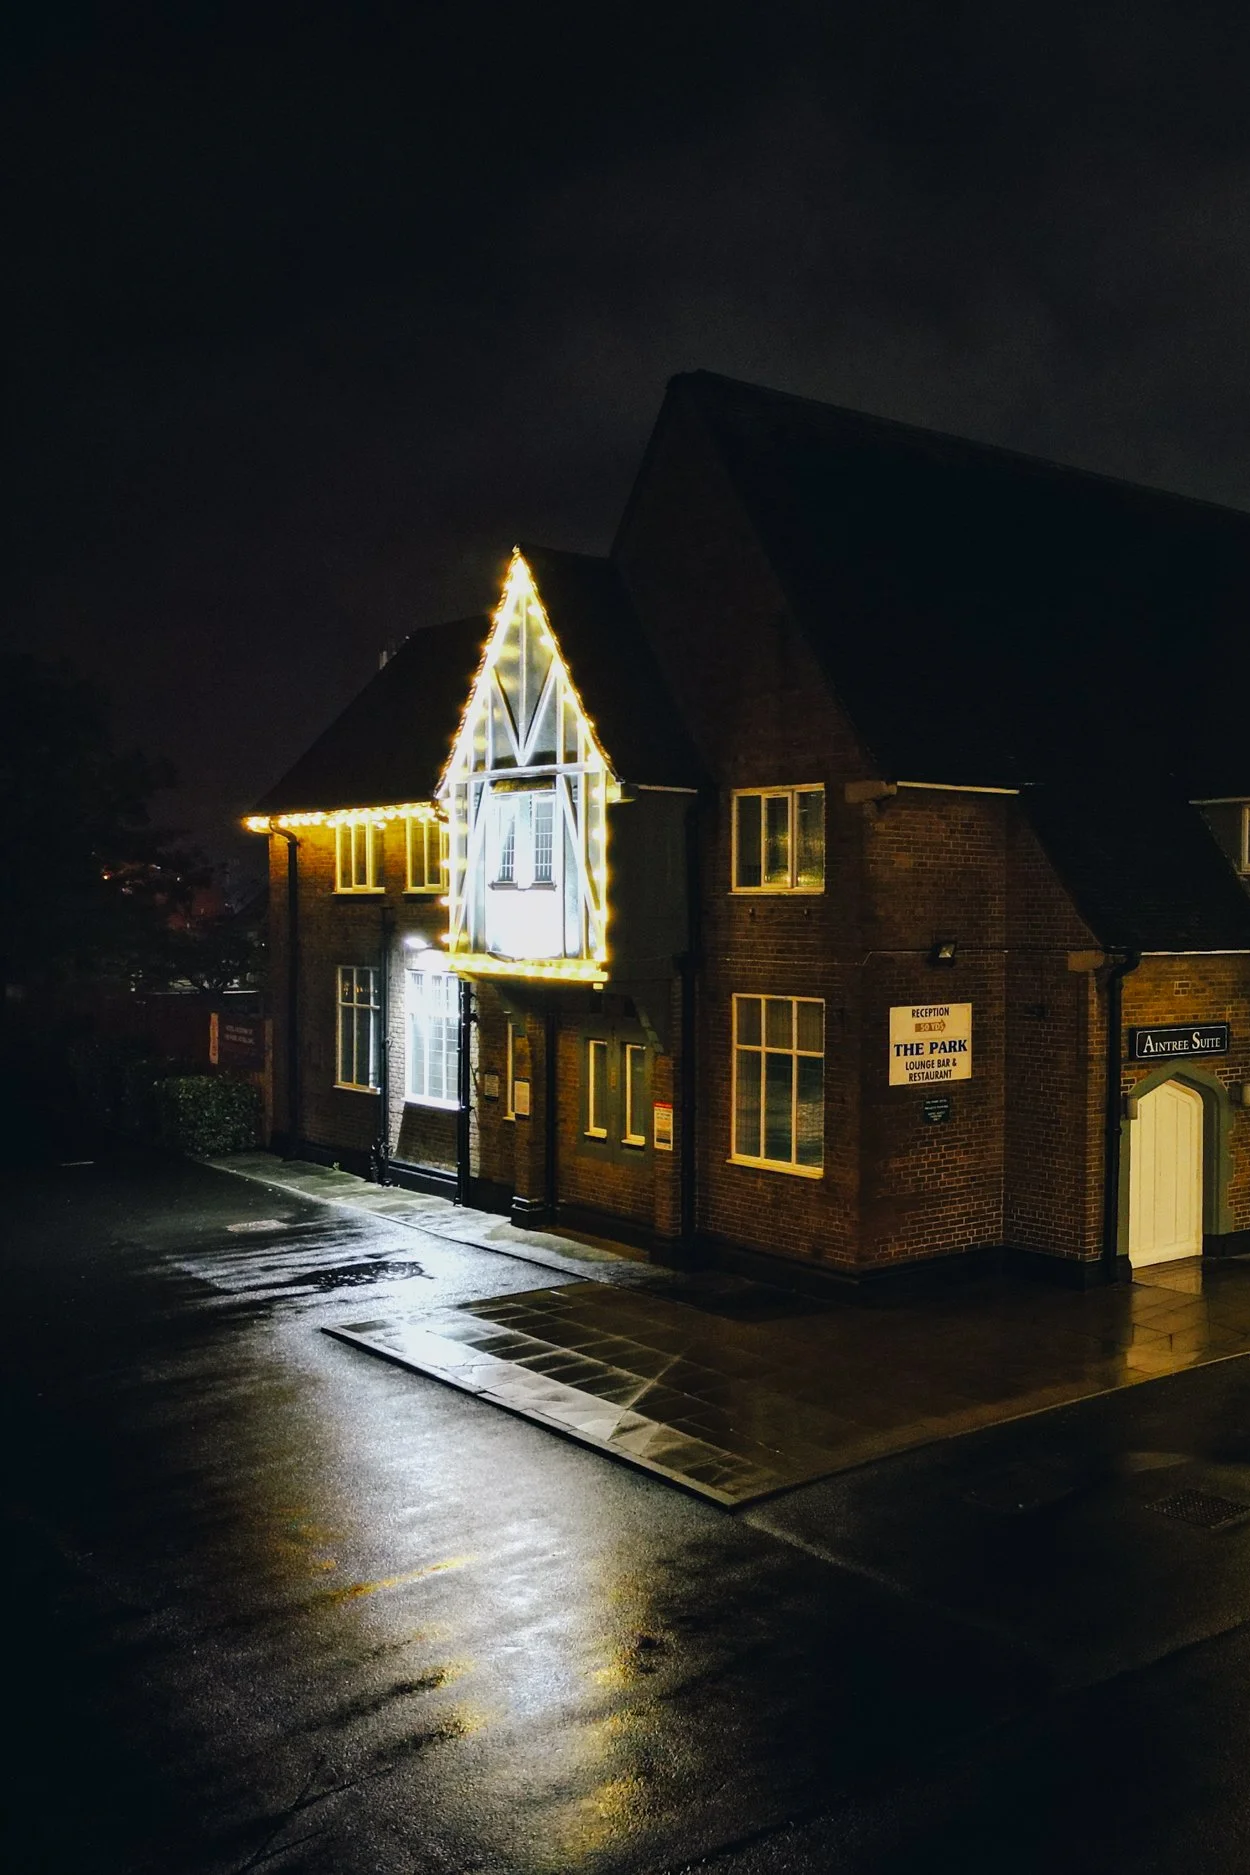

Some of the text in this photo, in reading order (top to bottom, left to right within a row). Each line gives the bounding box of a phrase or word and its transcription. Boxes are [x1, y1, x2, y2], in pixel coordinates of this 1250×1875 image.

[912, 1007, 949, 1018] RECEPTION
[920, 1022, 944, 1032] 50 YDS
[894, 1040, 967, 1056] THE PARK
[906, 1058, 957, 1070] LOUNGE BAR &
[909, 1070, 952, 1081] RESTAURANT
